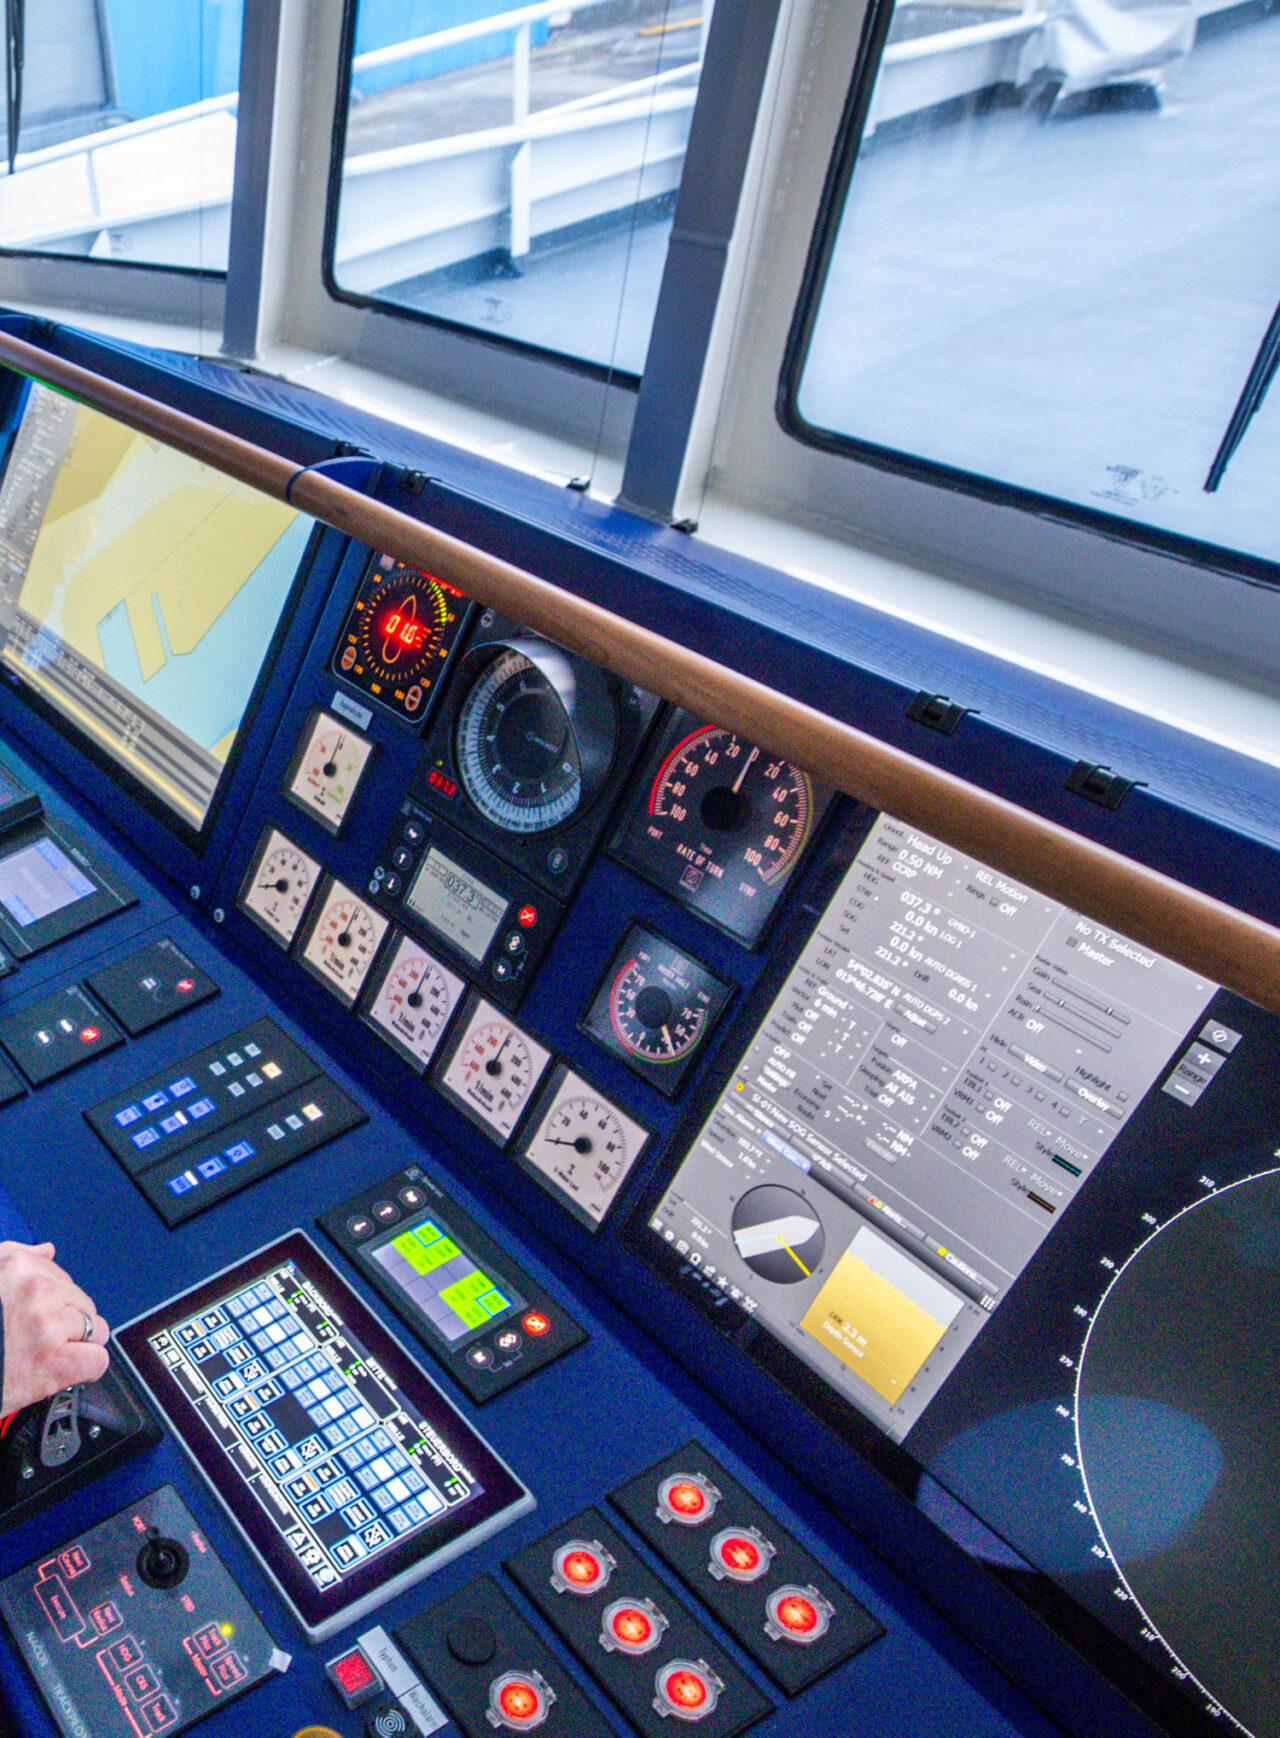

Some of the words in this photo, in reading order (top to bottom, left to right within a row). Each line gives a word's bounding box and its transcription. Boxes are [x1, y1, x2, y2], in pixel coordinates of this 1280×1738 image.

[704, 751, 719, 765] 40
[725, 742, 740, 758] 20
[685, 763, 699, 777] 60
[764, 763, 780, 779] 20
[672, 781, 687, 796] 80
[772, 787, 787, 802] 40
[669, 806, 687, 822] 100
[774, 811, 789, 827] 60
[764, 835, 780, 851] 80
[907, 834, 937, 855] Head
[936, 850, 953, 866] Up
[676, 843, 695, 861] RATE
[695, 854, 706, 865] OF
[705, 860, 724, 878] TURN
[744, 847, 762, 867] 100
[898, 850, 923, 869] 0.50
[922, 863, 943, 879] NM
[892, 861, 917, 879] CCRP
[976, 870, 994, 887] REL
[994, 881, 1027, 903] Motion
[856, 884, 871, 897] STW
[905, 910, 924, 928] 0.0
[923, 921, 938, 936] kn
[939, 931, 957, 944] LOG
[863, 871, 878, 886] HDG
[900, 890, 931, 914] 037.3
[947, 918, 976, 938] GYRO-1
[999, 902, 1017, 917] Off
[849, 896, 864, 910] COG
[889, 921, 916, 941] 221.2
[843, 910, 857, 922] SOG
[889, 936, 908, 954] 0.0
[908, 946, 924, 962] kn
[924, 957, 945, 974] AUTO
[1075, 921, 1091, 936] No
[1092, 930, 1109, 945] TX
[1108, 938, 1156, 968] Selected
[1078, 942, 1115, 967] Master
[875, 945, 901, 967] 221.2
[948, 987, 966, 1004] 0.0
[965, 997, 979, 1011] kn
[1032, 966, 1051, 982] Gain
[817, 985, 848, 1010] Ground
[884, 998, 894, 1009] E
[903, 992, 923, 1010] AUTO
[1015, 994, 1033, 1010] Rain
[804, 1009, 819, 1021] Off
[820, 1004, 837, 1018] min
[399, 1012, 415, 1032] 1/min
[798, 1021, 813, 1033] Off
[1026, 1019, 1045, 1034] Off
[791, 1032, 806, 1045] Off
[891, 1034, 908, 1048] Off
[773, 1045, 791, 1059] OFF
[990, 1032, 1008, 1049] Hide
[1024, 1052, 1047, 1072] Video
[892, 1069, 917, 1090] ARPA
[1074, 1065, 1112, 1092] Highlight
[1178, 1063, 1207, 1084] Range
[475, 1080, 494, 1103] 1/min
[878, 1094, 894, 1108] Off
[885, 1082, 897, 1094] All
[897, 1089, 915, 1106] AIS
[1077, 1087, 1111, 1111] Overlay
[561, 1117, 571, 1127] 20
[994, 1098, 1013, 1113] Off
[1027, 1118, 1047, 1135] REL
[1055, 1136, 1083, 1159] Move
[897, 1130, 914, 1146] NM
[985, 1110, 1004, 1125] Off
[1035, 1141, 1053, 1157] Style
[788, 1120, 807, 1137] SOG
[807, 1131, 832, 1156] Sensor
[832, 1150, 868, 1181] Selected
[891, 1140, 908, 1156] NM
[962, 1146, 981, 1160] Off
[597, 1160, 611, 1175] 100
[970, 1134, 988, 1148] Off
[1003, 1154, 1022, 1172] REL
[1029, 1172, 1057, 1195] Move
[842, 1322, 859, 1338] 2.3
[856, 1335, 867, 1347] m
[50, 1594, 67, 1620] Execute
[120, 1644, 133, 1662] HDG
[378, 1647, 397, 1672] Typhon
[136, 1674, 149, 1690] CRS
[152, 1702, 167, 1723] Track
[408, 1690, 438, 1728] Wachalarm
